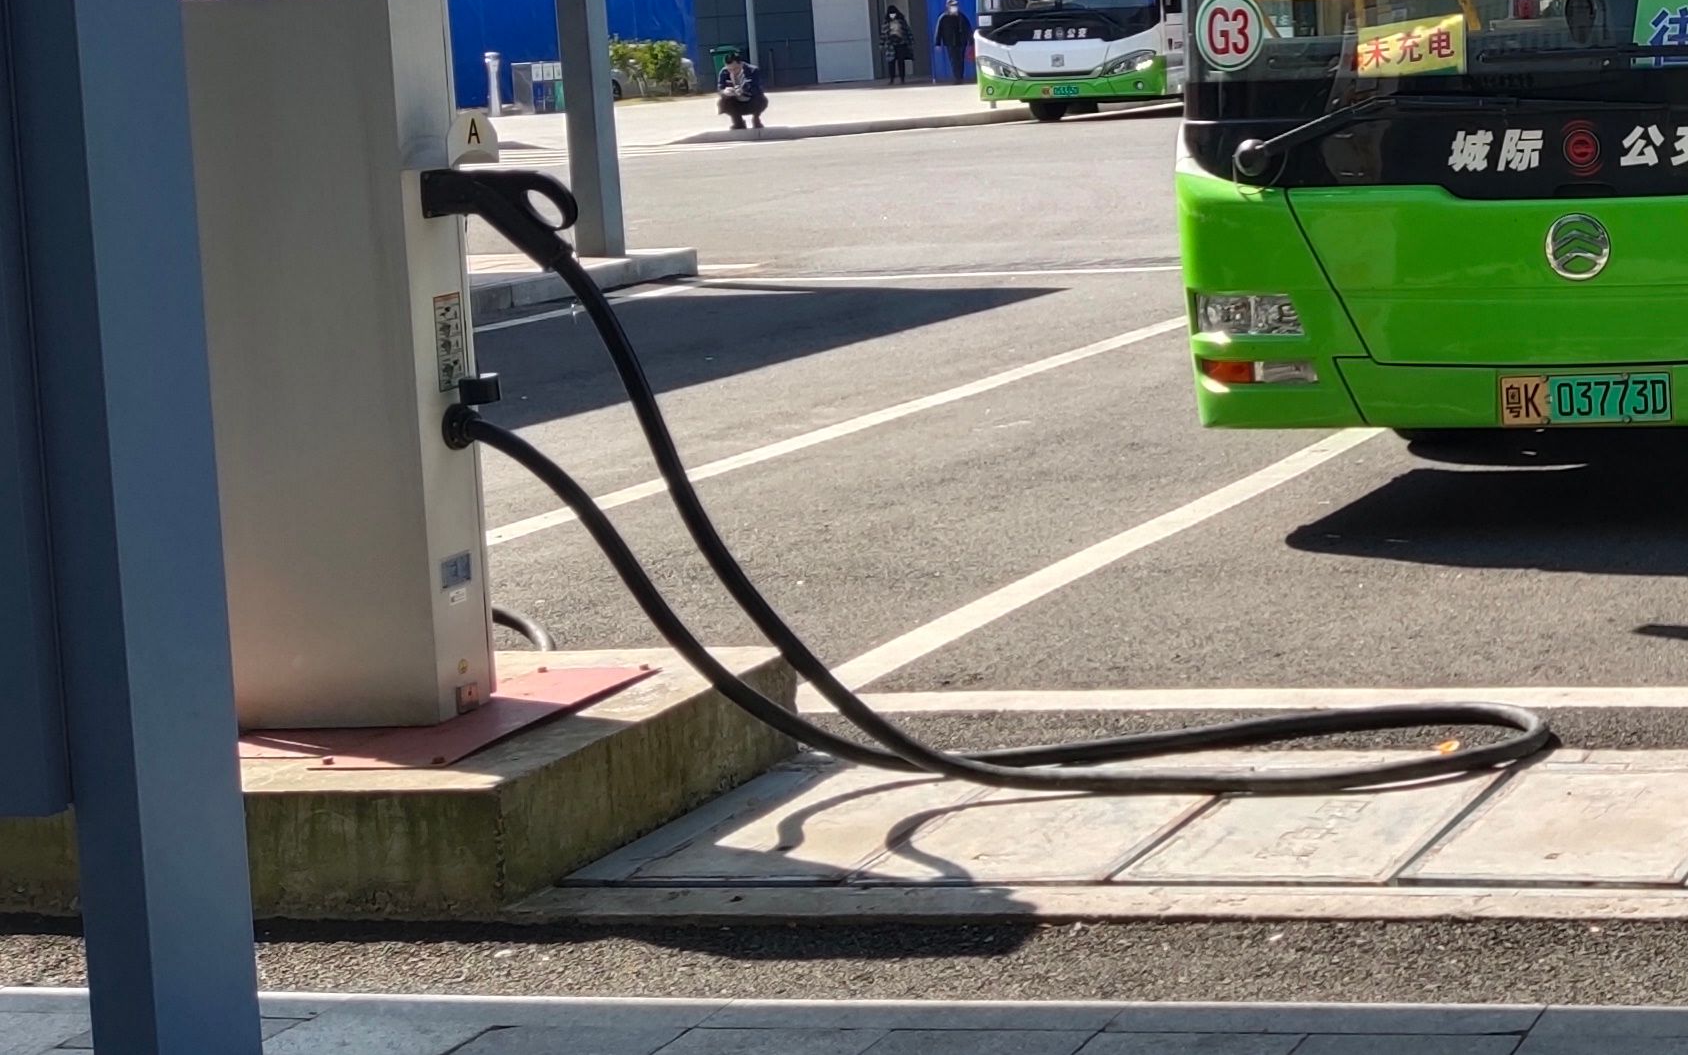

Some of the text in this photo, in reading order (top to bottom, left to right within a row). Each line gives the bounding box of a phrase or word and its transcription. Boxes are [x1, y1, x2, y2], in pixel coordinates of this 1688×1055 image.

[1206, 6, 1250, 56] G3
[467, 117, 481, 144] A
[1447, 128, 1544, 173] 城际
[1556, 379, 1668, 417] 03773D
